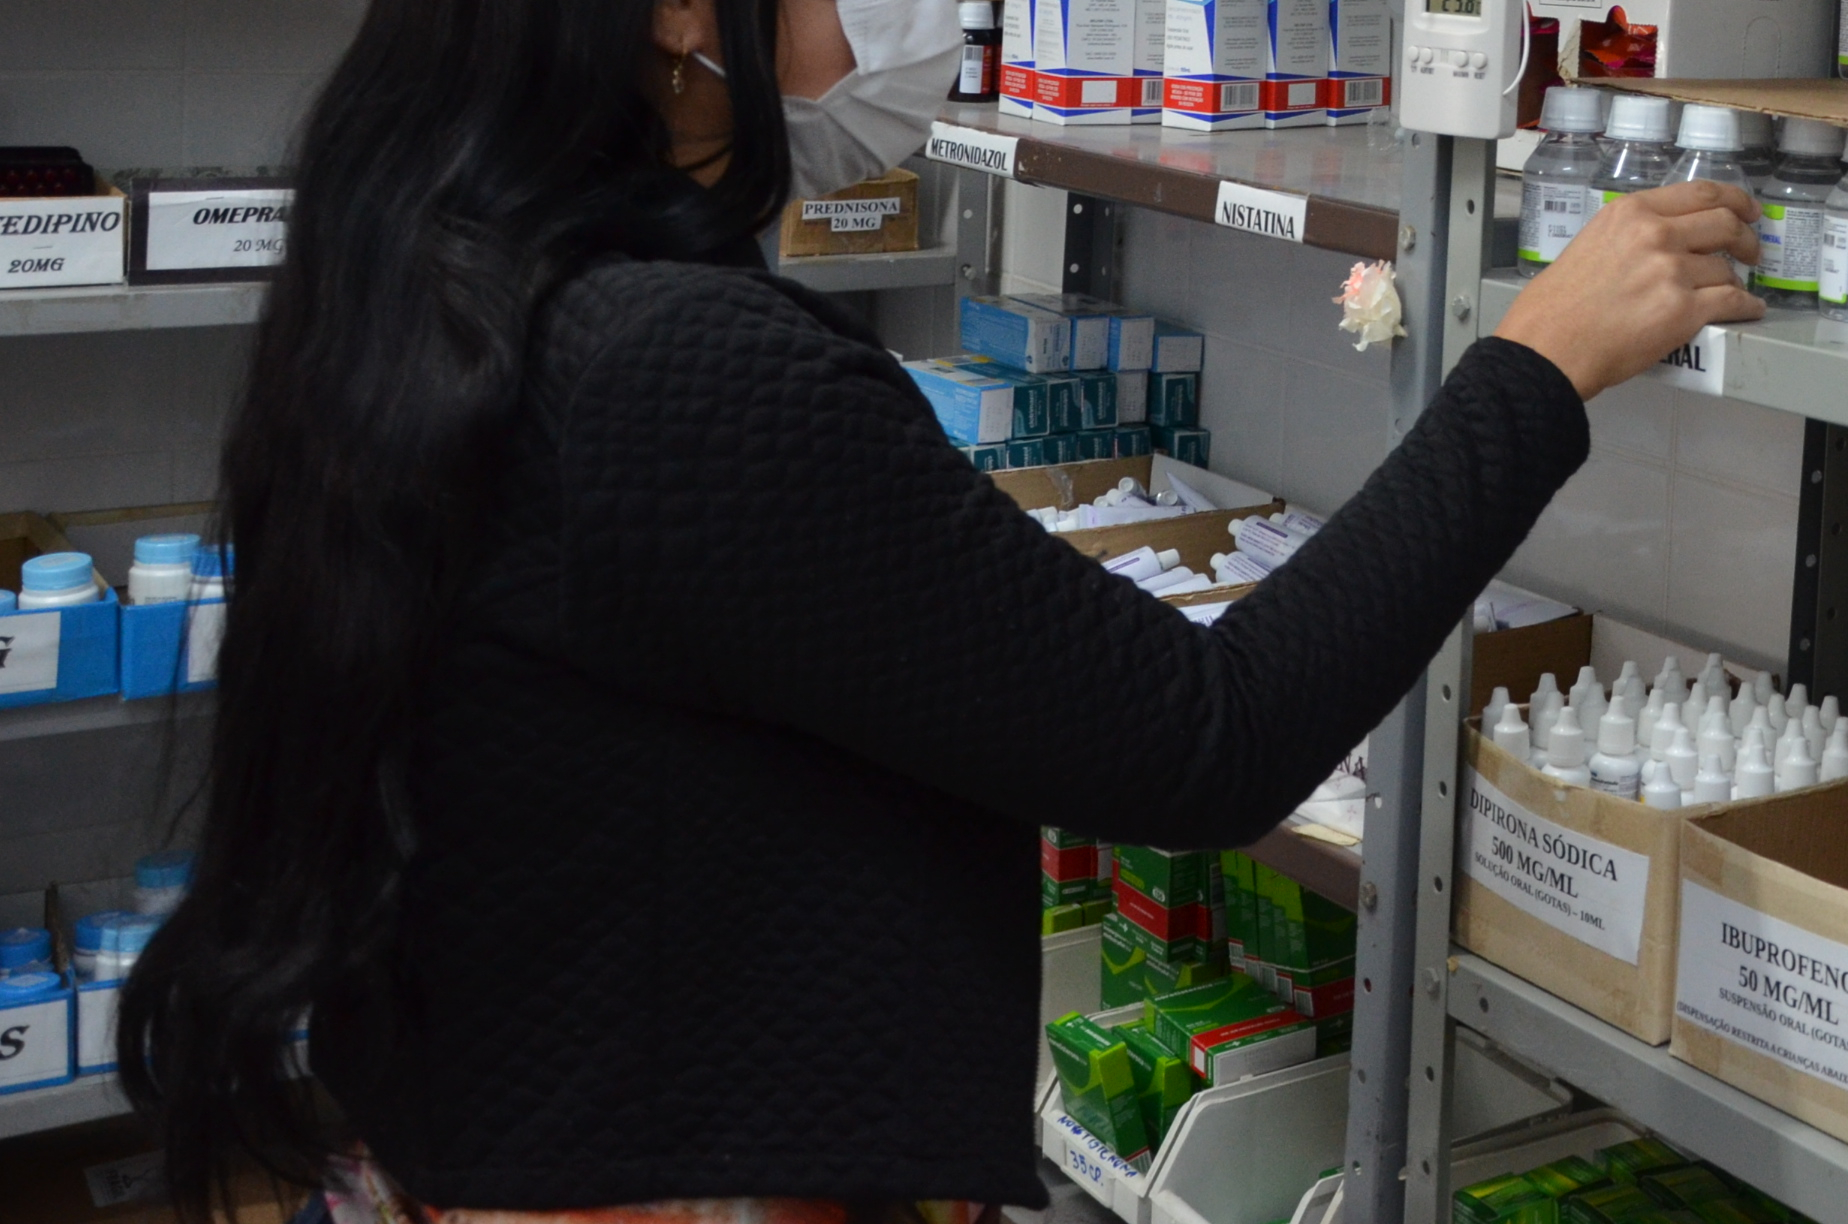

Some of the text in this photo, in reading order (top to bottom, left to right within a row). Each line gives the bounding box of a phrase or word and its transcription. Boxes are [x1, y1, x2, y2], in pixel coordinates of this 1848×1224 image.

[931, 136, 1008, 171] METRONIDAZOL
[805, 201, 898, 214] PREDNISONA
[833, 217, 876, 228] 20 MG
[1223, 203, 1295, 239] NISTATINA
[233, 240, 284, 254] 20 MG
[8, 258, 65, 273] 20MG
[1659, 343, 1706, 372] RAL
[1470, 788, 1618, 882] DIPIRONA SÓDICA
[1492, 836, 1579, 899] 500 MG/ML
[1475, 852, 1605, 930] SOLUÇÃO ORAL (GOTAS) 10ML
[1719, 987, 1777, 1023] SUSPENSÃO
[1779, 1013, 1810, 1036] ORAL
[1738, 965, 1839, 1026] 50 MG/ML
[1677, 1001, 1730, 1033] (DISPENSAÇÃO
[1731, 1025, 1770, 1051] RESTRITA
[1769, 1044, 1777, 1054] A
[1777, 1046, 1820, 1072] CRIANÇAS
